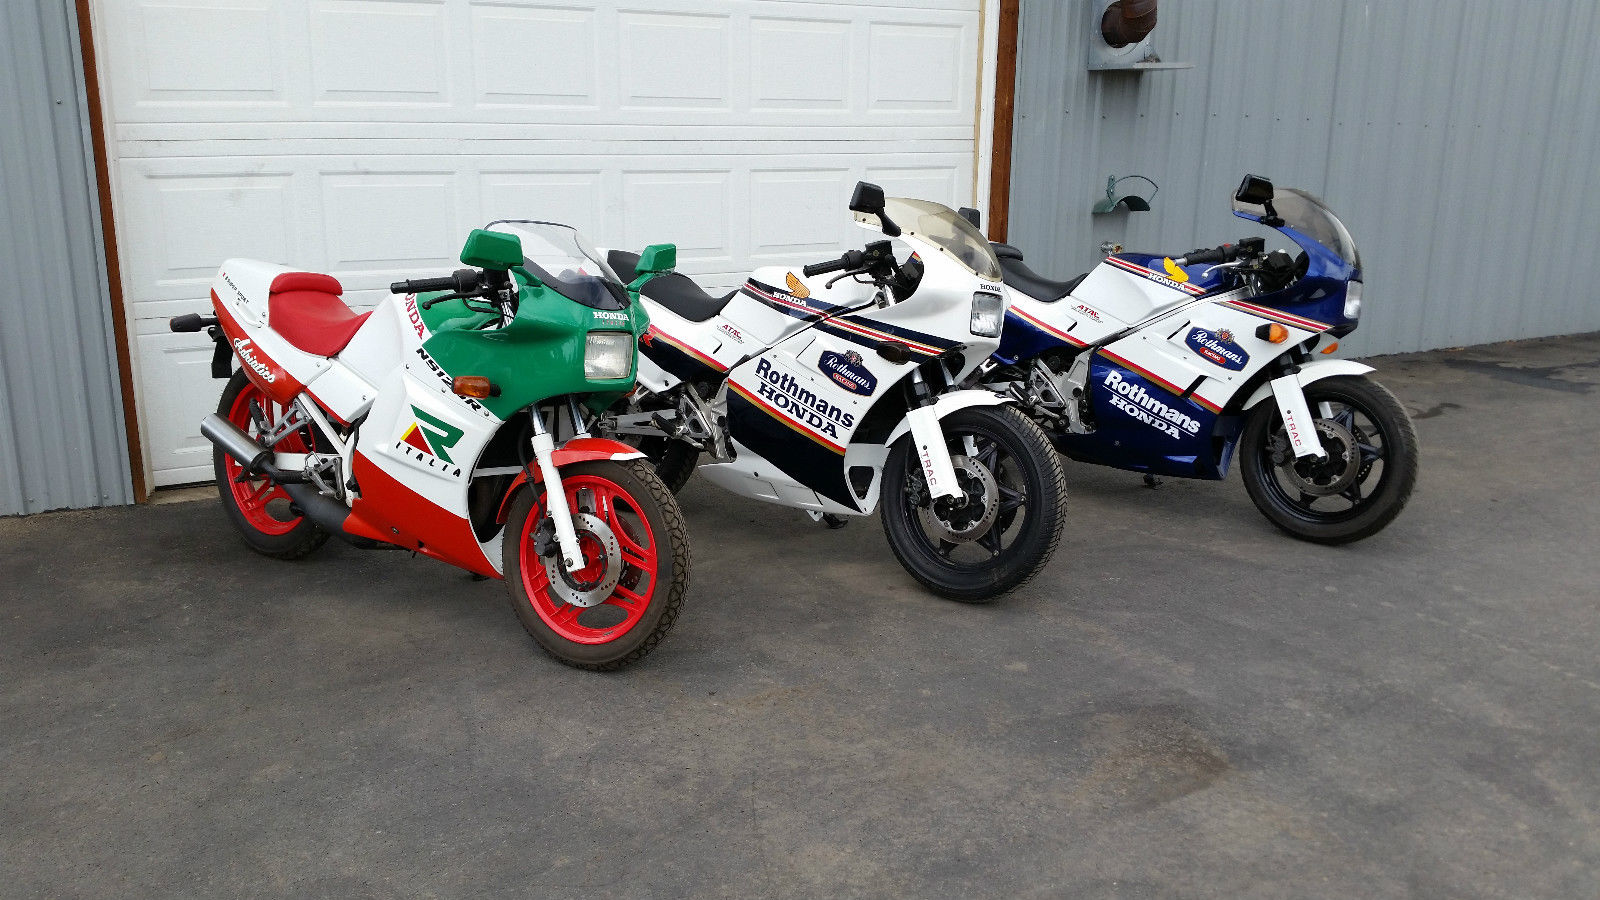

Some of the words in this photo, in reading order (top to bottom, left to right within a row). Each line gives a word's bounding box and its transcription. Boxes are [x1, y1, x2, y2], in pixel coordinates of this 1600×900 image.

[773, 291, 807, 307] HONDA
[1148, 273, 1186, 290] HONDA
[404, 292, 425, 340] ONDA
[593, 312, 629, 321] HONDA
[233, 337, 275, 383] Adriatico
[1192, 330, 1243, 364] Rothmans
[824, 354, 871, 390] Rothmans
[755, 357, 855, 428] Rothmans
[757, 381, 838, 439] HONDA
[1103, 370, 1201, 433] Rothmans
[1109, 393, 1181, 440] HONDA
[1287, 415, 1302, 447] TRAC
[395, 441, 461, 477] ITALIA
[922, 450, 937, 486] TRAC
